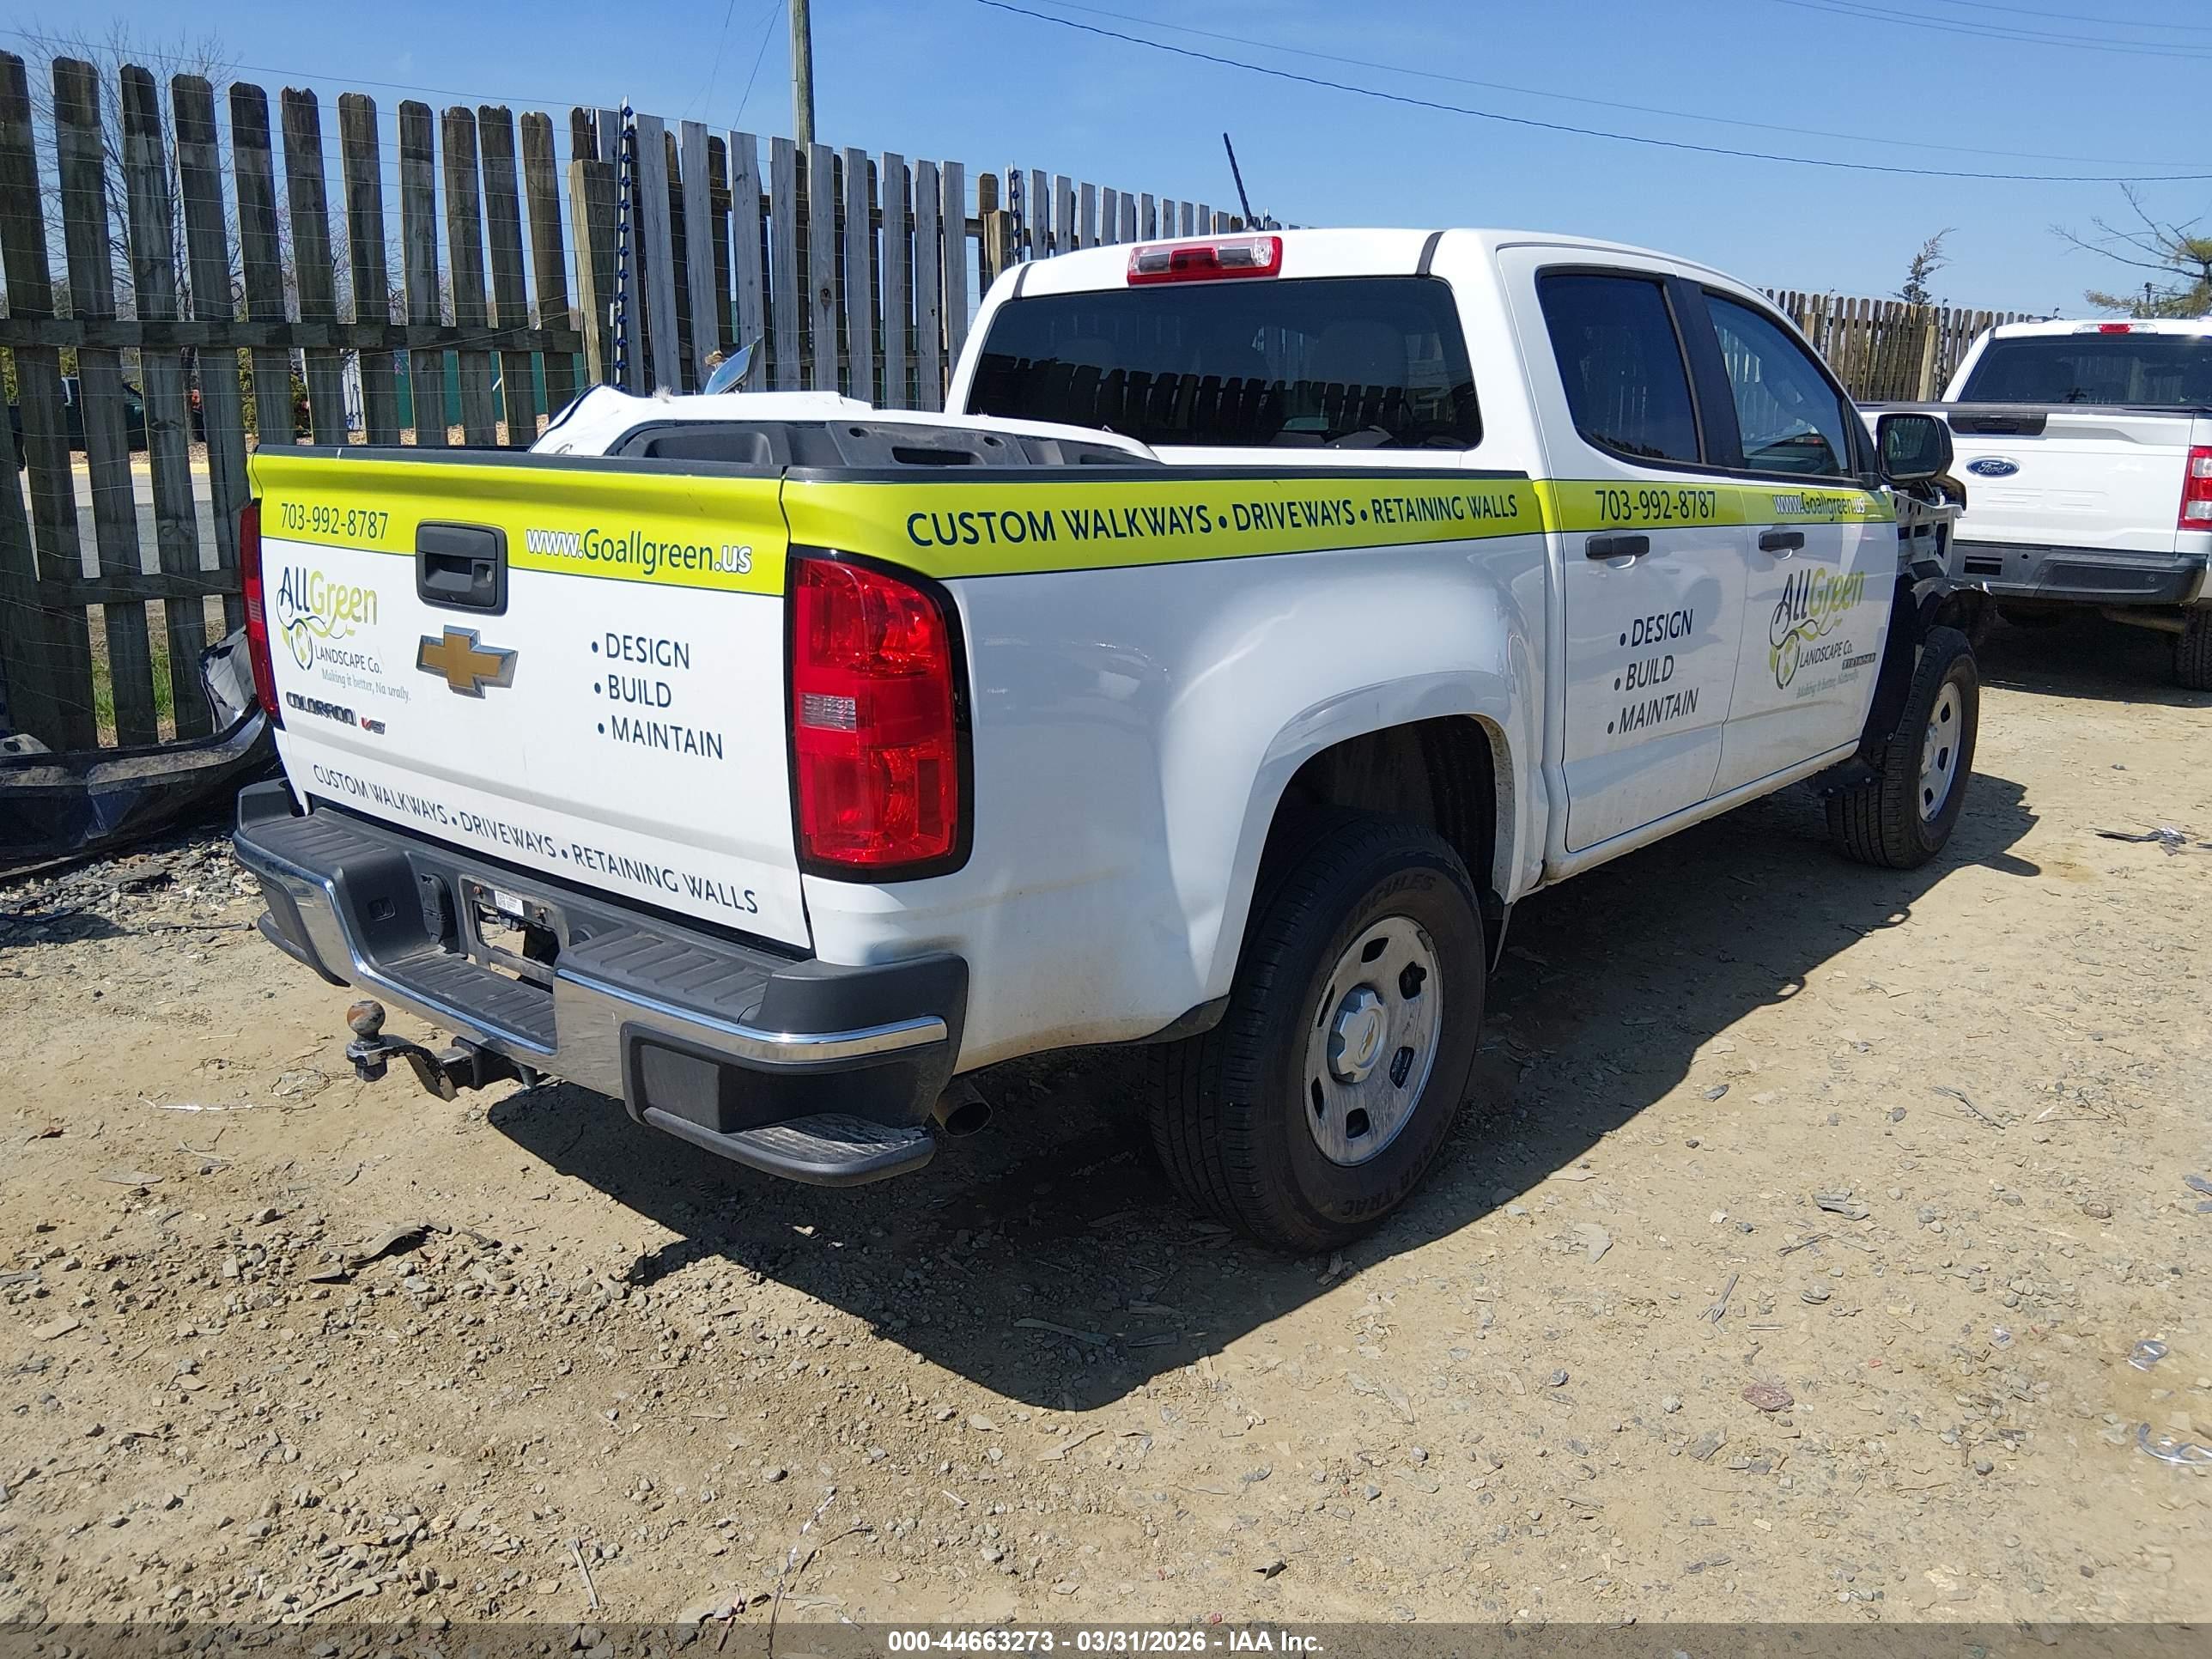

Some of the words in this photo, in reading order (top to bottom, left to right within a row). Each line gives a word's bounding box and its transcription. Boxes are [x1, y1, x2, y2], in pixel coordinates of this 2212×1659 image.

[280, 502, 389, 540] 703-992-8787
[907, 510, 1057, 546] CUSTOM
[1060, 505, 1212, 541] WALKWAYS
[1231, 499, 1355, 532] DRIVEWAYS
[1372, 495, 1464, 525] RETAINING
[1467, 494, 1518, 520] WALLS
[1595, 489, 1717, 521] 703-992-8787
[1772, 491, 1865, 521] www.Goallgreen.us
[526, 528, 752, 575] www.Goallgreen.us
[278, 566, 379, 626] AllGreen
[1774, 567, 1865, 625] AllGreen
[1632, 608, 1693, 647] DESIGN
[314, 644, 367, 671] LANDSCAPE
[368, 657, 383, 674] Co.
[605, 632, 690, 670] DESIGN
[1799, 641, 1844, 668] LANDSCAPE
[1844, 640, 1853, 655] Co.
[608, 674, 672, 708] BUILD
[1626, 655, 1674, 691] BUILD
[375, 682, 412, 704] Naurally.
[1619, 687, 1699, 734] MAINTAIN
[611, 714, 723, 760] MAINTAIN
[313, 764, 370, 799] CUSTOM
[368, 782, 449, 825] WALKWAYS
[459, 811, 556, 858] DRIVEWAYS
[571, 843, 679, 893] RETAINING
[682, 872, 758, 915] WALLS
